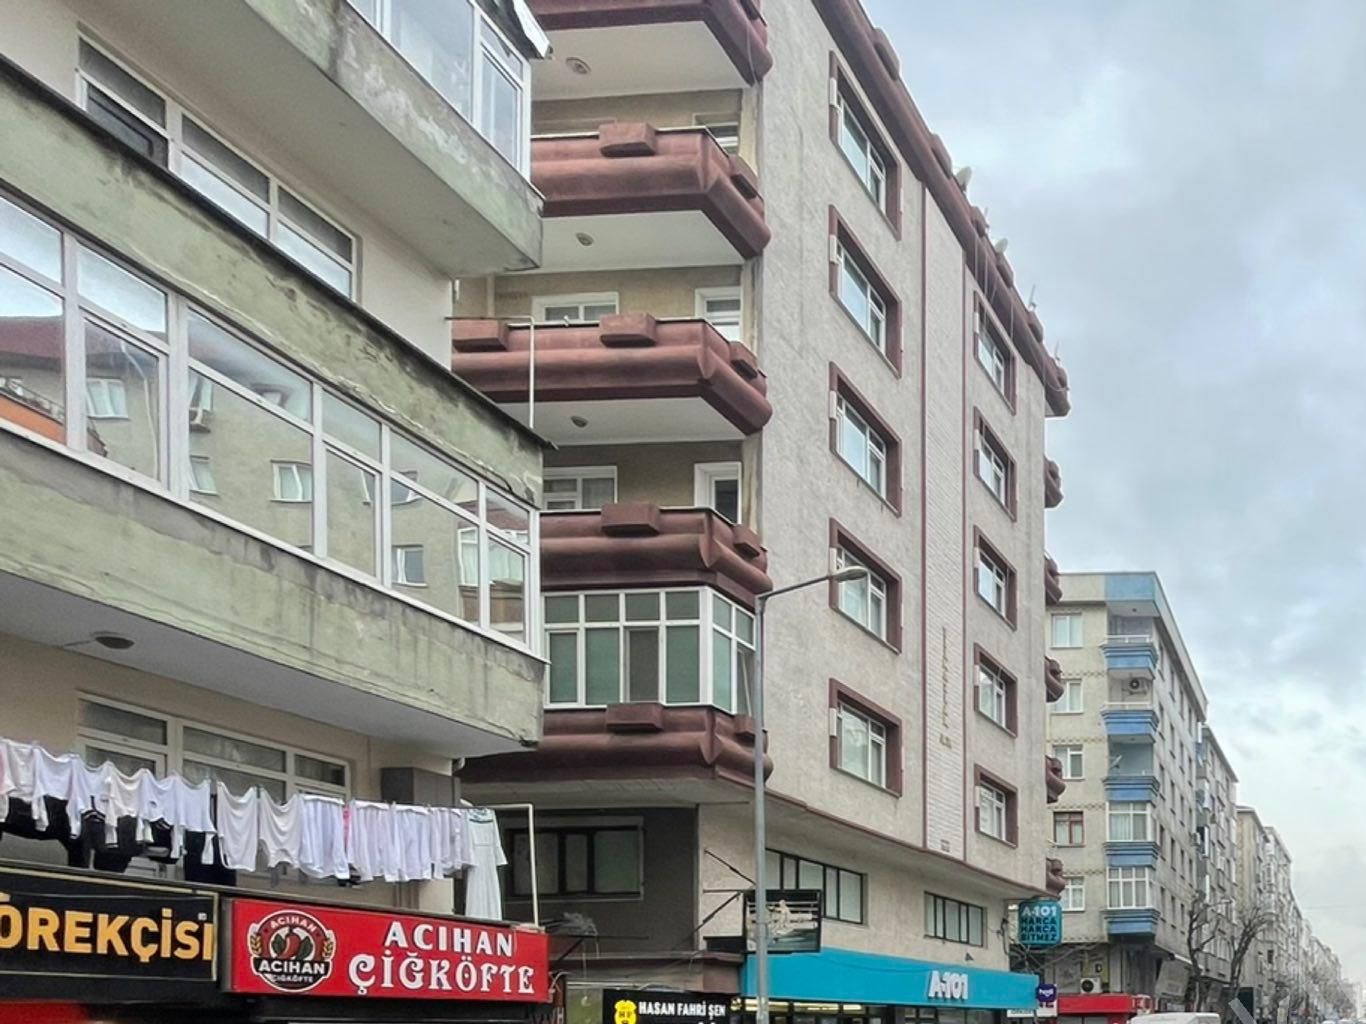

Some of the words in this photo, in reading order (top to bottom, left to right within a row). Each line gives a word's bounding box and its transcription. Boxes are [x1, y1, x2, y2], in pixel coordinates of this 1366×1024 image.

[270, 916, 317, 932] ACIHAN
[384, 921, 513, 957] ACIHAN
[259, 960, 325, 974] ACIHAN
[349, 949, 535, 996] ÇİĞKÖFTE
[639, 1001, 676, 1016] HASAN
[677, 1001, 707, 1017] FAHRİ
[708, 1004, 726, 1020] ŞEN
